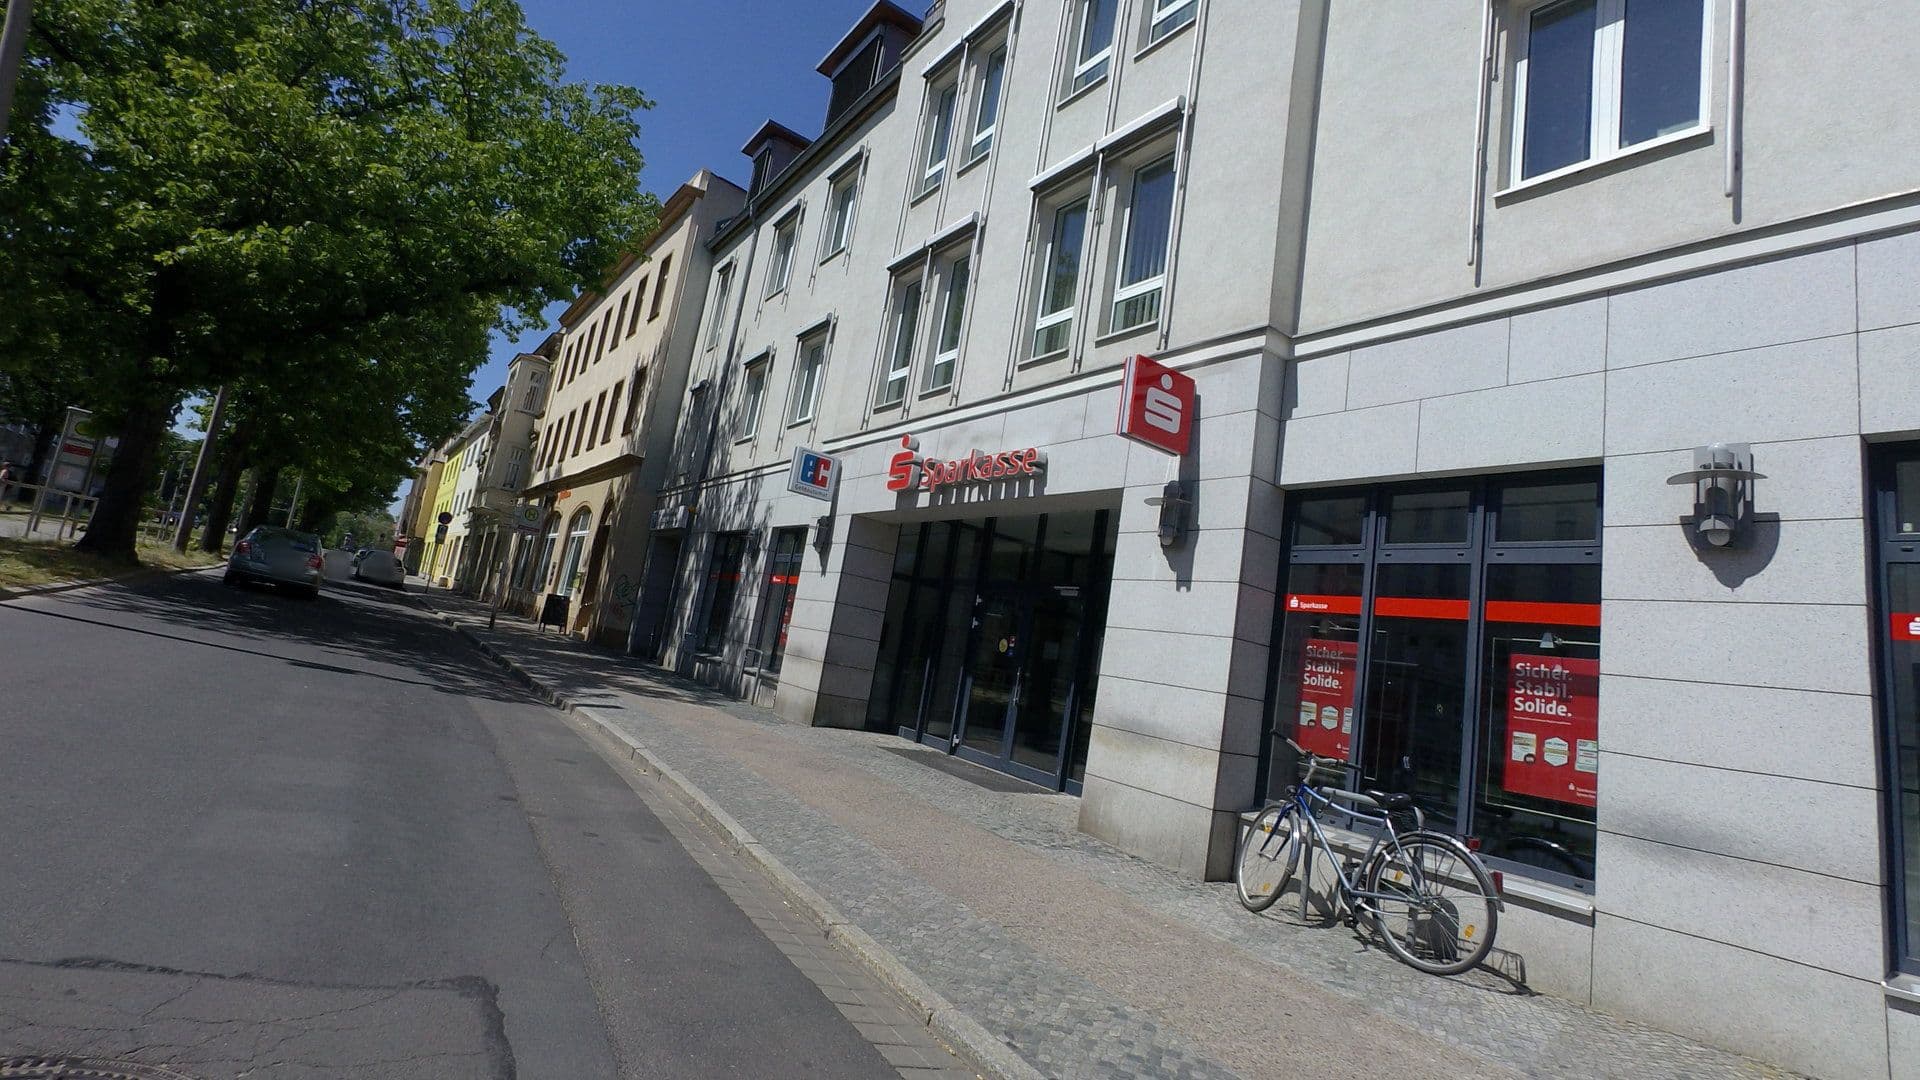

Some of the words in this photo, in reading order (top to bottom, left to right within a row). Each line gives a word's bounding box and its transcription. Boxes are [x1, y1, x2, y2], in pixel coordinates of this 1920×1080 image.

[919, 447, 1038, 493] Sparkasse
[1300, 602, 1329, 610] Sparkasse
[1305, 645, 1345, 660] Sicher.
[1304, 659, 1344, 675] Stabil.
[1515, 662, 1573, 681] Sicher.
[1303, 673, 1342, 689] Solide.
[1514, 680, 1573, 699] Stabil.
[1513, 696, 1573, 718] Solide.
